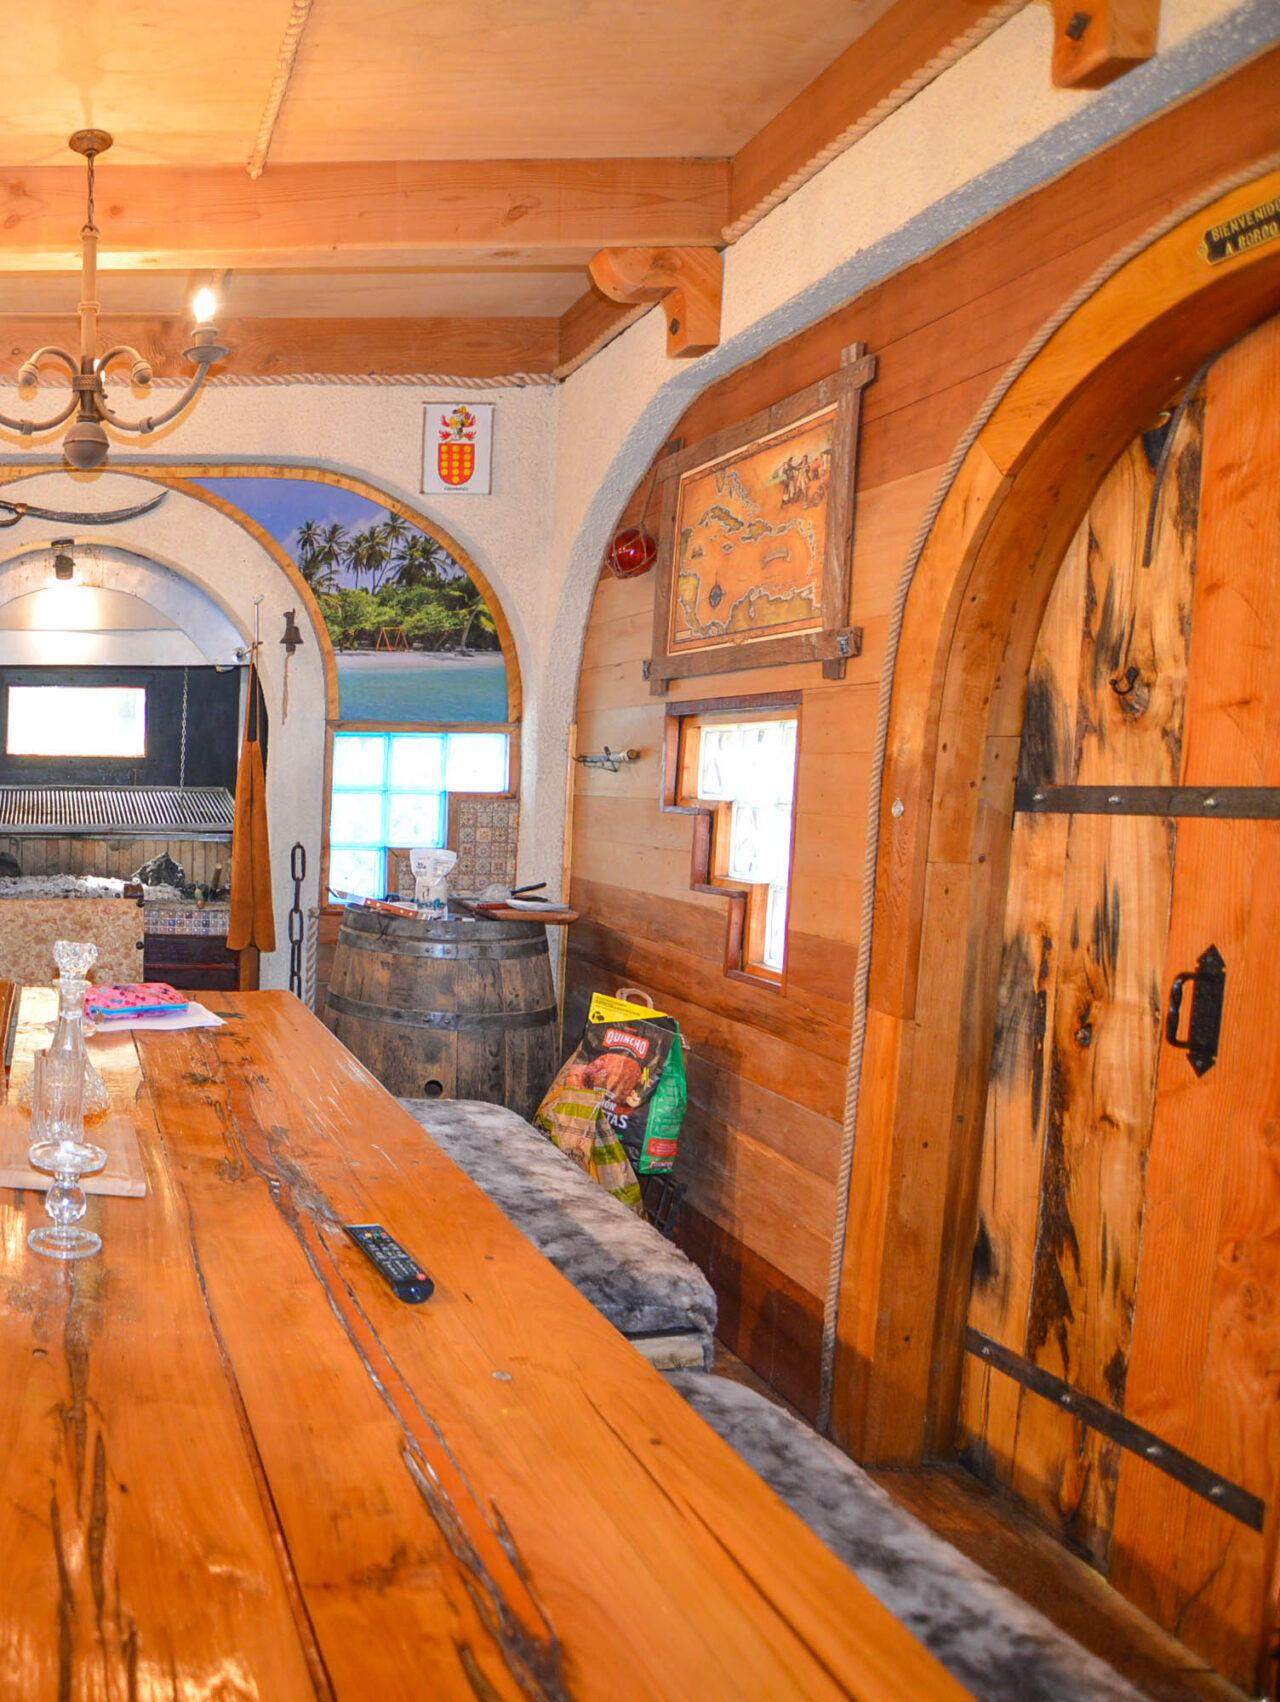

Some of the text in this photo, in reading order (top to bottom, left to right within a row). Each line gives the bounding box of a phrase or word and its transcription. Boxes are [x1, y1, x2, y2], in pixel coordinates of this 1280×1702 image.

[1226, 242, 1234, 255] A
[605, 1030, 648, 1056] QUINCHO
[605, 1111, 629, 1129] TAS
